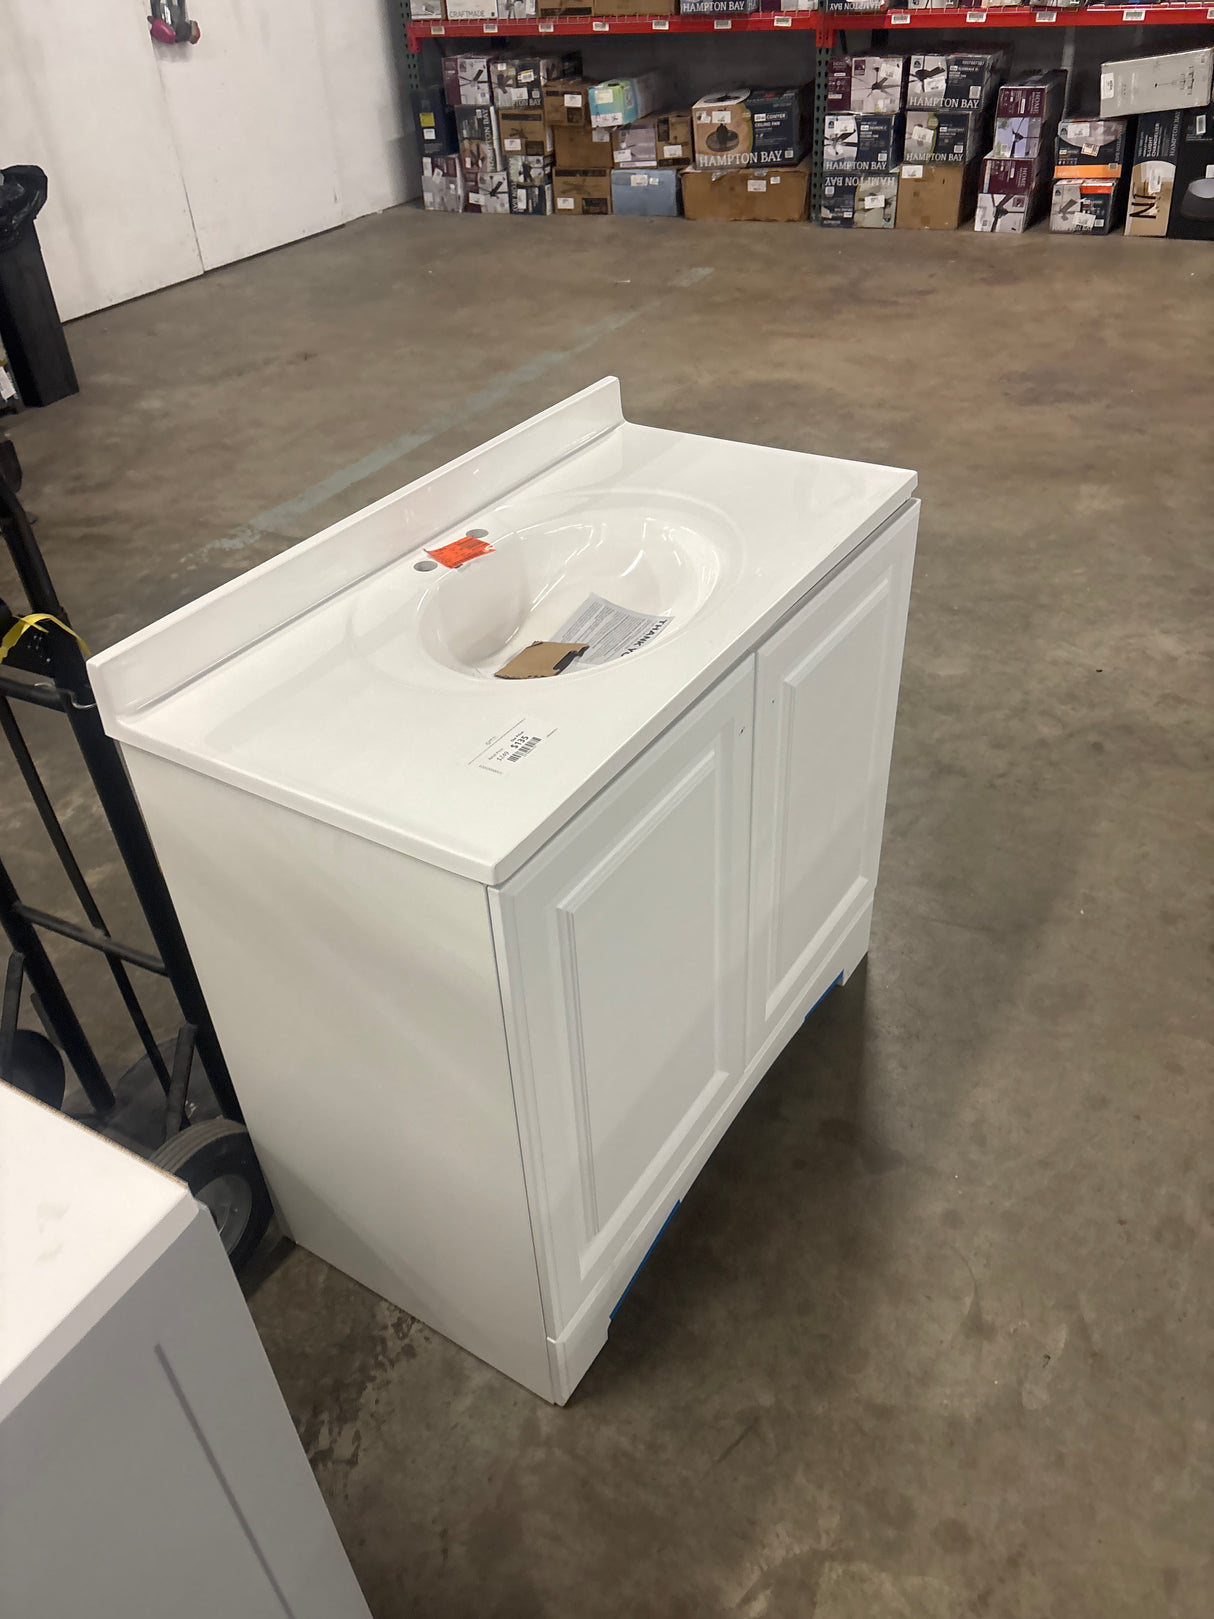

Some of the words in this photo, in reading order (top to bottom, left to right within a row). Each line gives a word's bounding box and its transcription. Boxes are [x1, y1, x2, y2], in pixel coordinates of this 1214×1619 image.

[683, 2, 726, 12] HAMPTON
[728, 1, 745, 11] BAY
[829, 2, 843, 10] BAY
[449, 10, 485, 18] CRAFTMADE
[909, 96, 959, 108] HAMPTON
[961, 98, 979, 109] BAY
[1152, 122, 1160, 157] CHANDELIER
[1169, 124, 1178, 157] HAMPTON
[699, 152, 758, 167] HAMPTON
[760, 150, 783, 163] BAY
[906, 152, 947, 161] HAMPTON
[948, 153, 964, 162] BAY
[826, 161, 869, 170] HAMPTON
[871, 161, 887, 170] BAY
[824, 176, 843, 186] BAY
[845, 176, 895, 186] HAMPTON
[633, 619, 668, 647] THANK
[510, 736, 529, 748] $135
